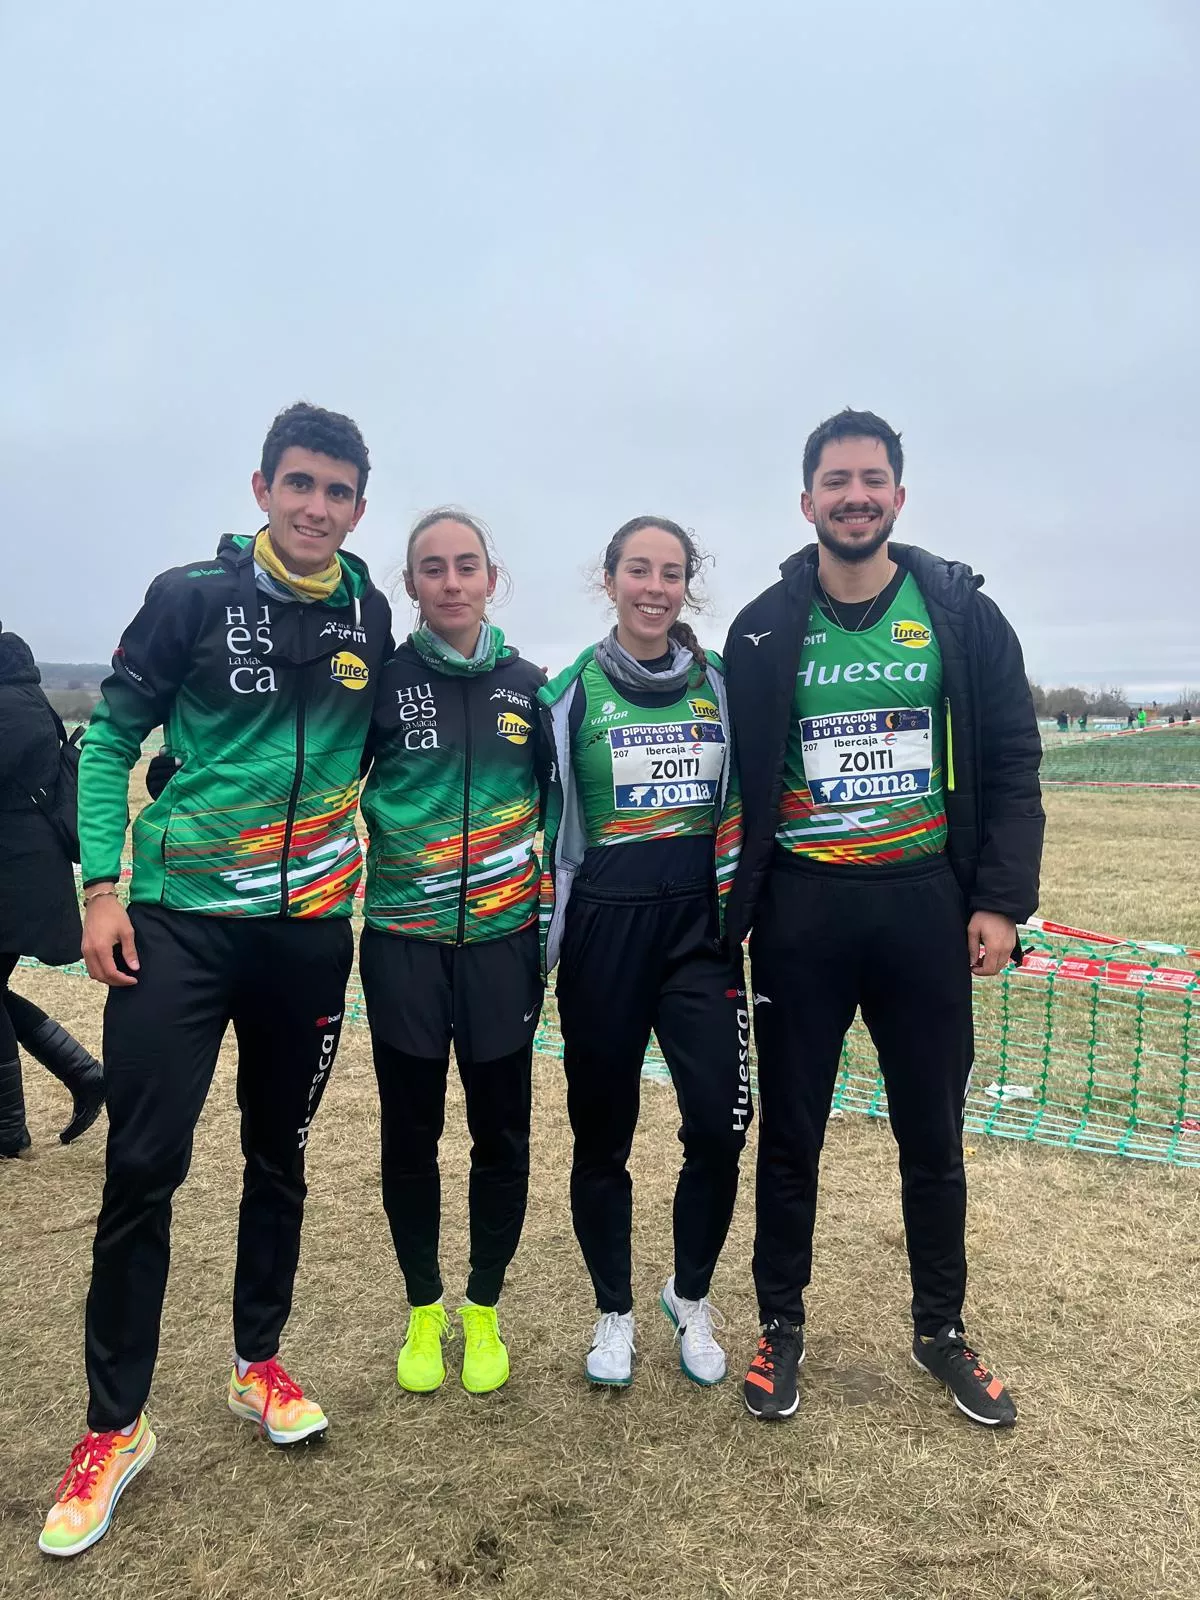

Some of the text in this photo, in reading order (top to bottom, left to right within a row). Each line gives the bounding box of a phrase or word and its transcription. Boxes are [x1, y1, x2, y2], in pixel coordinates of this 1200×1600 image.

[803, 632, 827, 646] OITI
[229, 666, 278, 694] ca
[591, 710, 628, 726] VIATOR
[811, 711, 877, 729] DIPUTACIÓN
[622, 724, 683, 737] DIPUTACIÓN
[813, 722, 878, 739] BURGOS
[624, 733, 685, 746] BURGOS
[803, 732, 929, 752] 207 Ibercaja 4
[613, 750, 629, 759] 207
[646, 744, 686, 756] Ibercaja
[651, 758, 700, 780] ZOITI
[839, 748, 894, 773] ZOITI
[732, 1008, 749, 1131] Huesca
